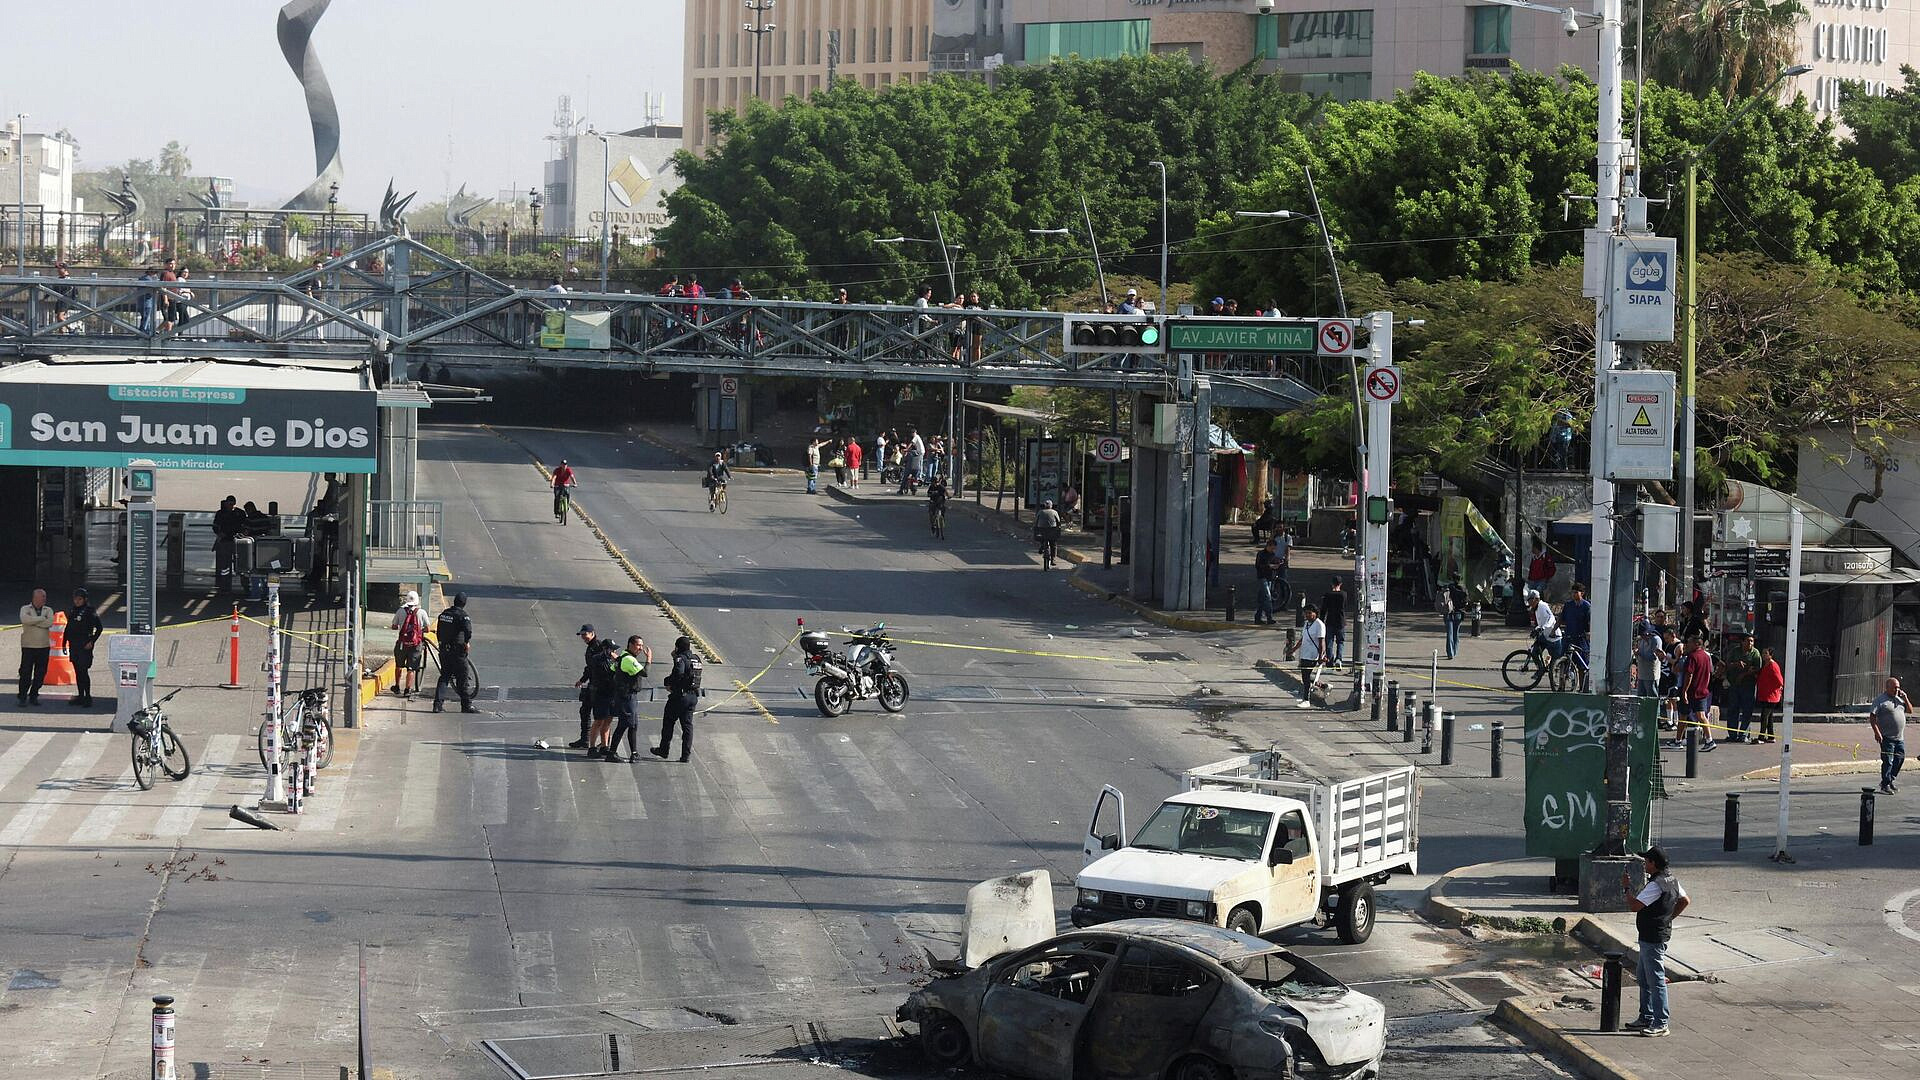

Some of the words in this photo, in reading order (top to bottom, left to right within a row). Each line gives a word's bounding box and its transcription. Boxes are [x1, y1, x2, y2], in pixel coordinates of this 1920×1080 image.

[1819, 22, 1888, 62] CENTRO
[1633, 268, 1660, 279] agua
[1629, 294, 1662, 306] SIAPA
[1181, 331, 1203, 343] AV.
[1207, 331, 1258, 345] JAVIER
[1266, 332, 1303, 345] MINA
[118, 386, 179, 398] Estación
[181, 388, 236, 401] Express
[30, 412, 107, 443] San
[117, 414, 218, 444] Juan
[227, 417, 276, 447] de
[286, 418, 369, 449] Dios
[1625, 427, 1637, 435] ALTA
[1637, 428, 1658, 436] TENSION
[1103, 443, 1115, 453] 50
[181, 458, 225, 469] Mirador
